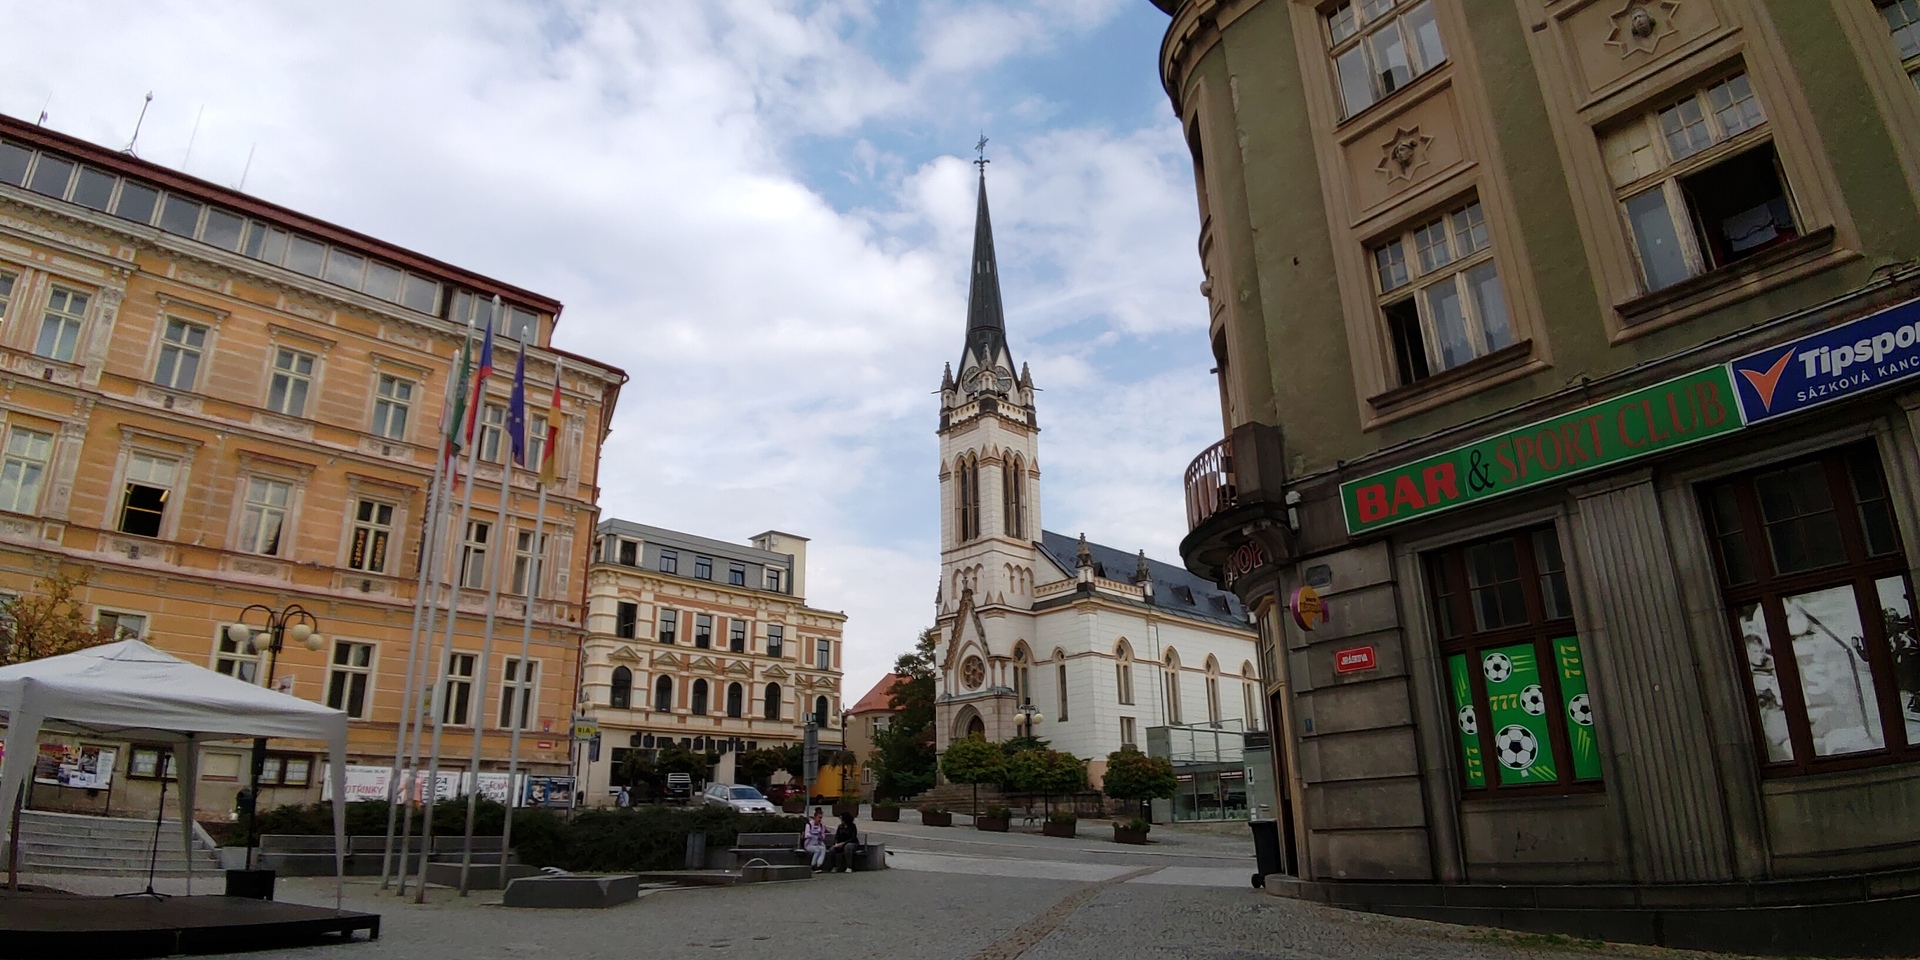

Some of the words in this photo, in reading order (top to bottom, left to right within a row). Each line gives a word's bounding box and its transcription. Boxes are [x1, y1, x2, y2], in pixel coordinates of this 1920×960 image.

[1797, 369, 1870, 402] SÁZKOVÁ
[1355, 462, 1460, 524] BAR
[1468, 448, 1496, 493] &
[1496, 413, 1604, 484] SPORT
[1617, 381, 1727, 449] CLUB
[1561, 645, 1581, 679] 777
[1489, 693, 1518, 711] 777
[1466, 747, 1482, 780] 777
